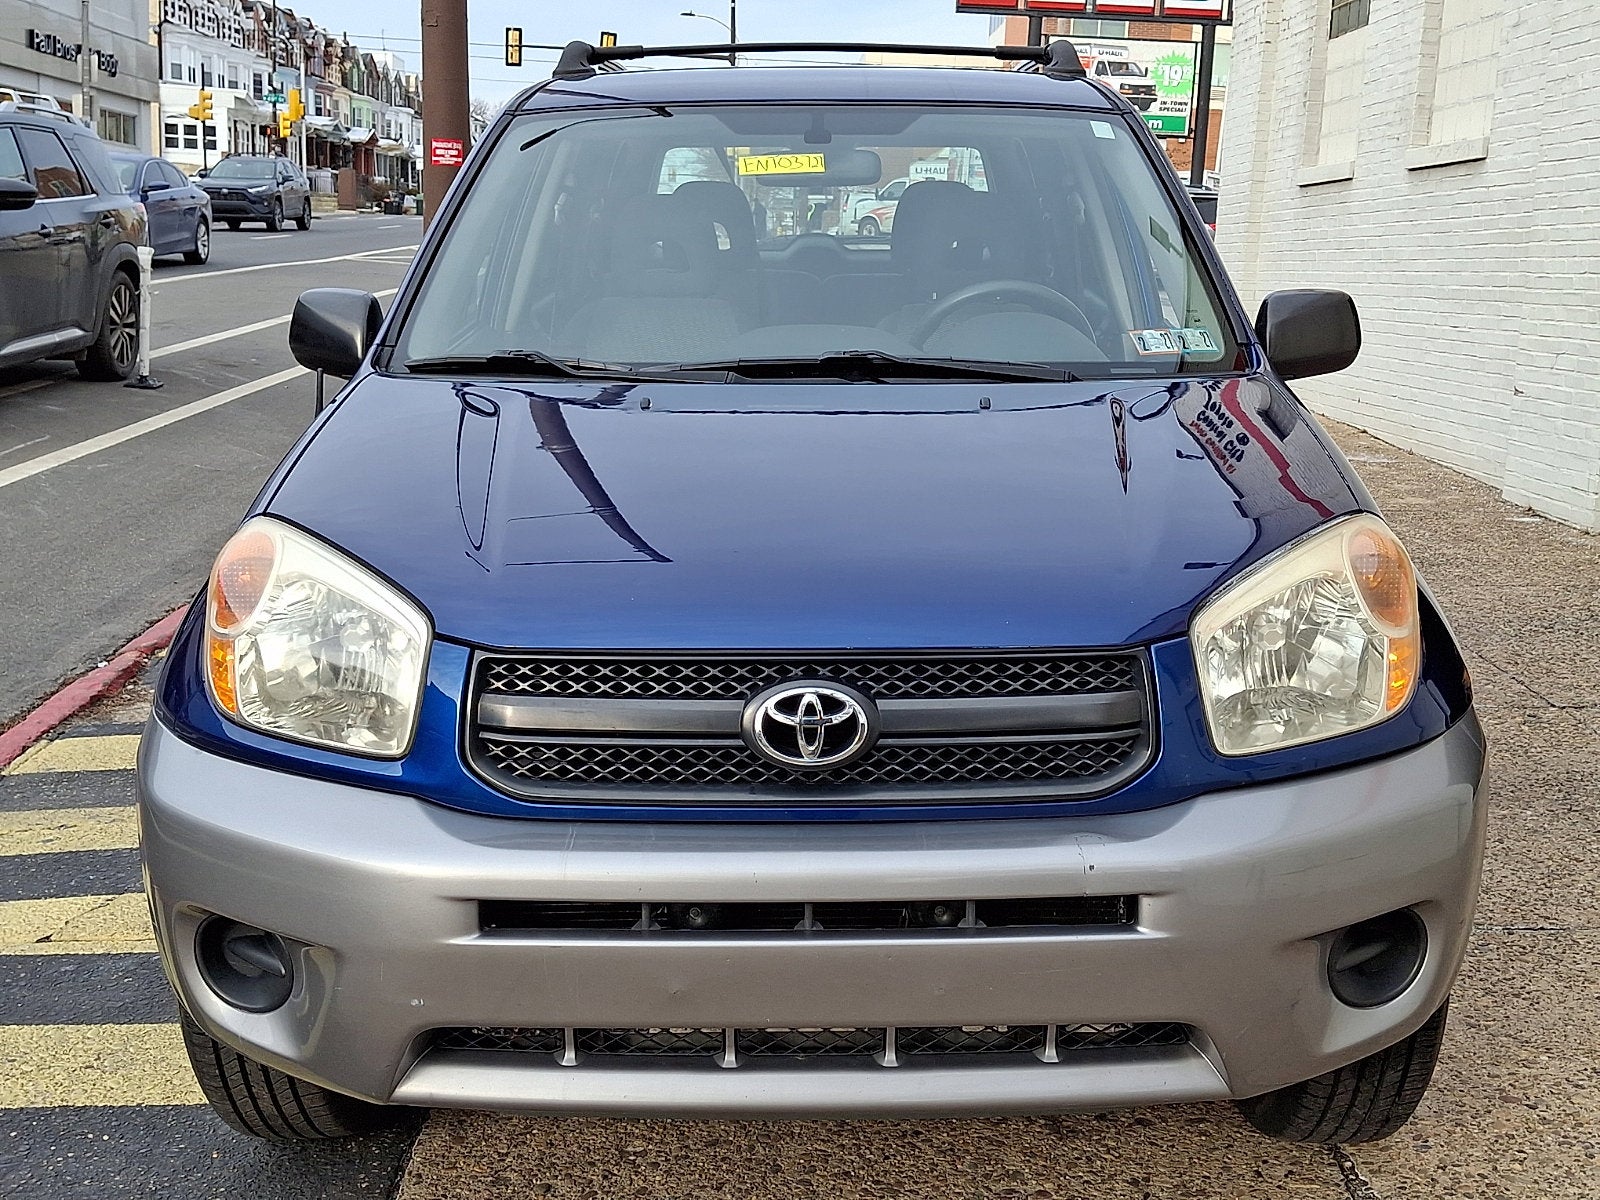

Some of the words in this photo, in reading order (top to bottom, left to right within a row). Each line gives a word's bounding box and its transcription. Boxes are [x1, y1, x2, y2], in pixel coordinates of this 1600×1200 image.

[34, 29, 54, 55] Paul
[56, 35, 77, 61] Bros
[915, 167, 946, 175] U-HAU
